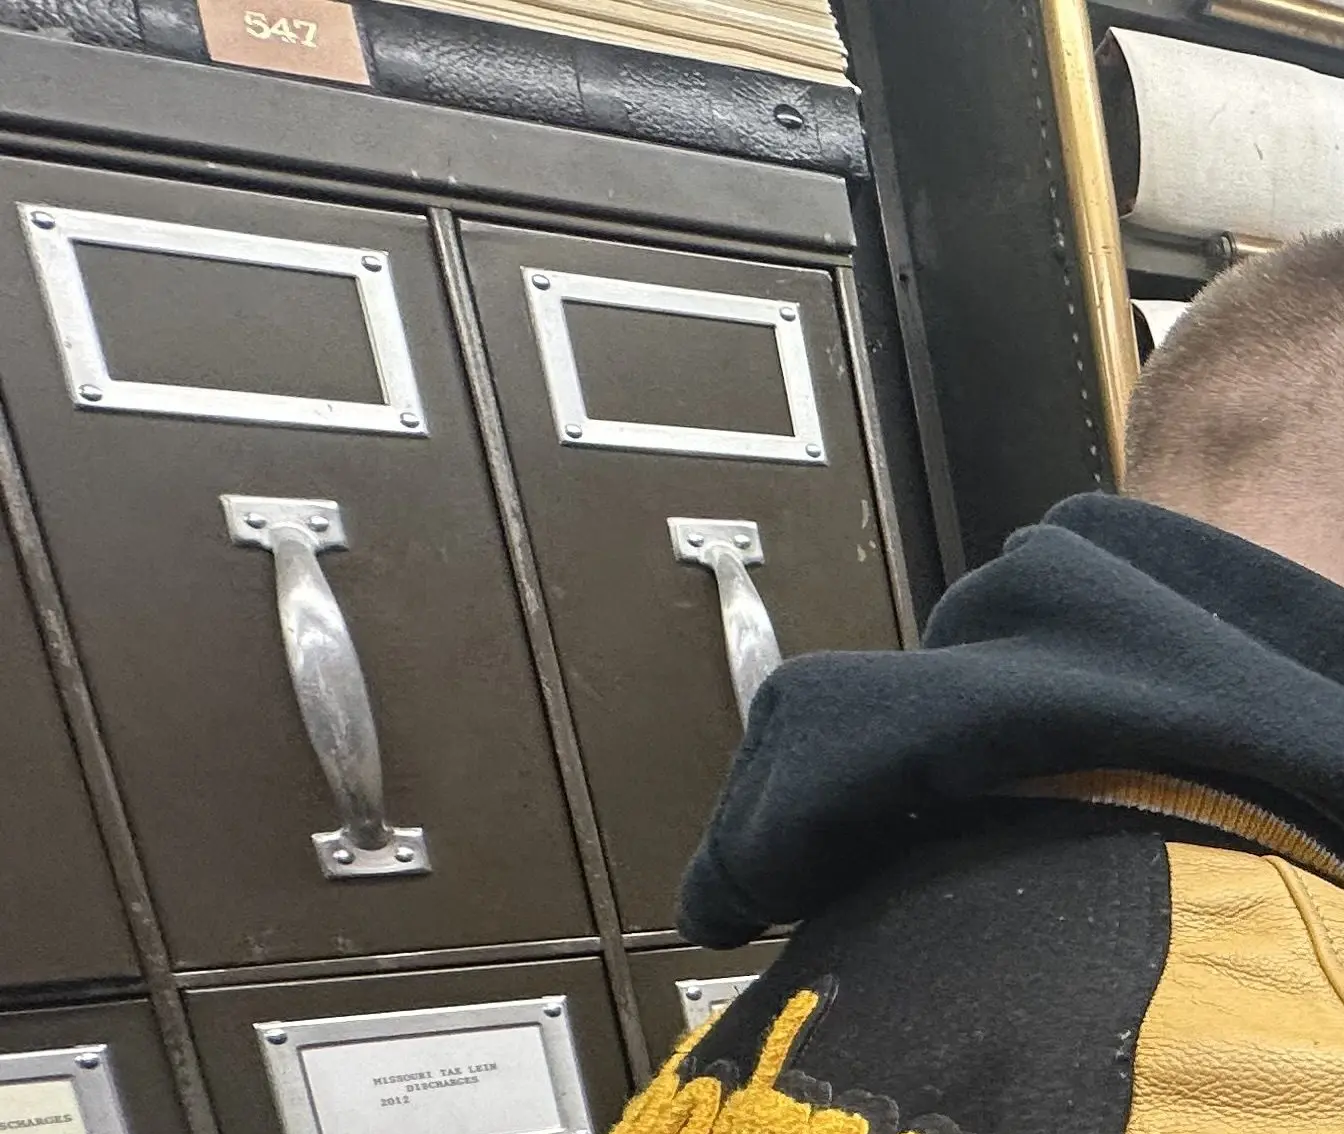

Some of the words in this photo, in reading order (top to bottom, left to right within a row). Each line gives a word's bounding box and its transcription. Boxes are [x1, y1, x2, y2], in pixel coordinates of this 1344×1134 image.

[244, 11, 318, 48] 547
[373, 1072, 432, 1086] MISSOURI
[440, 1067, 463, 1077] TAX
[468, 1062, 497, 1074] LEIN
[406, 1076, 479, 1092] DISCHARGES
[380, 1096, 410, 1107] 2012
